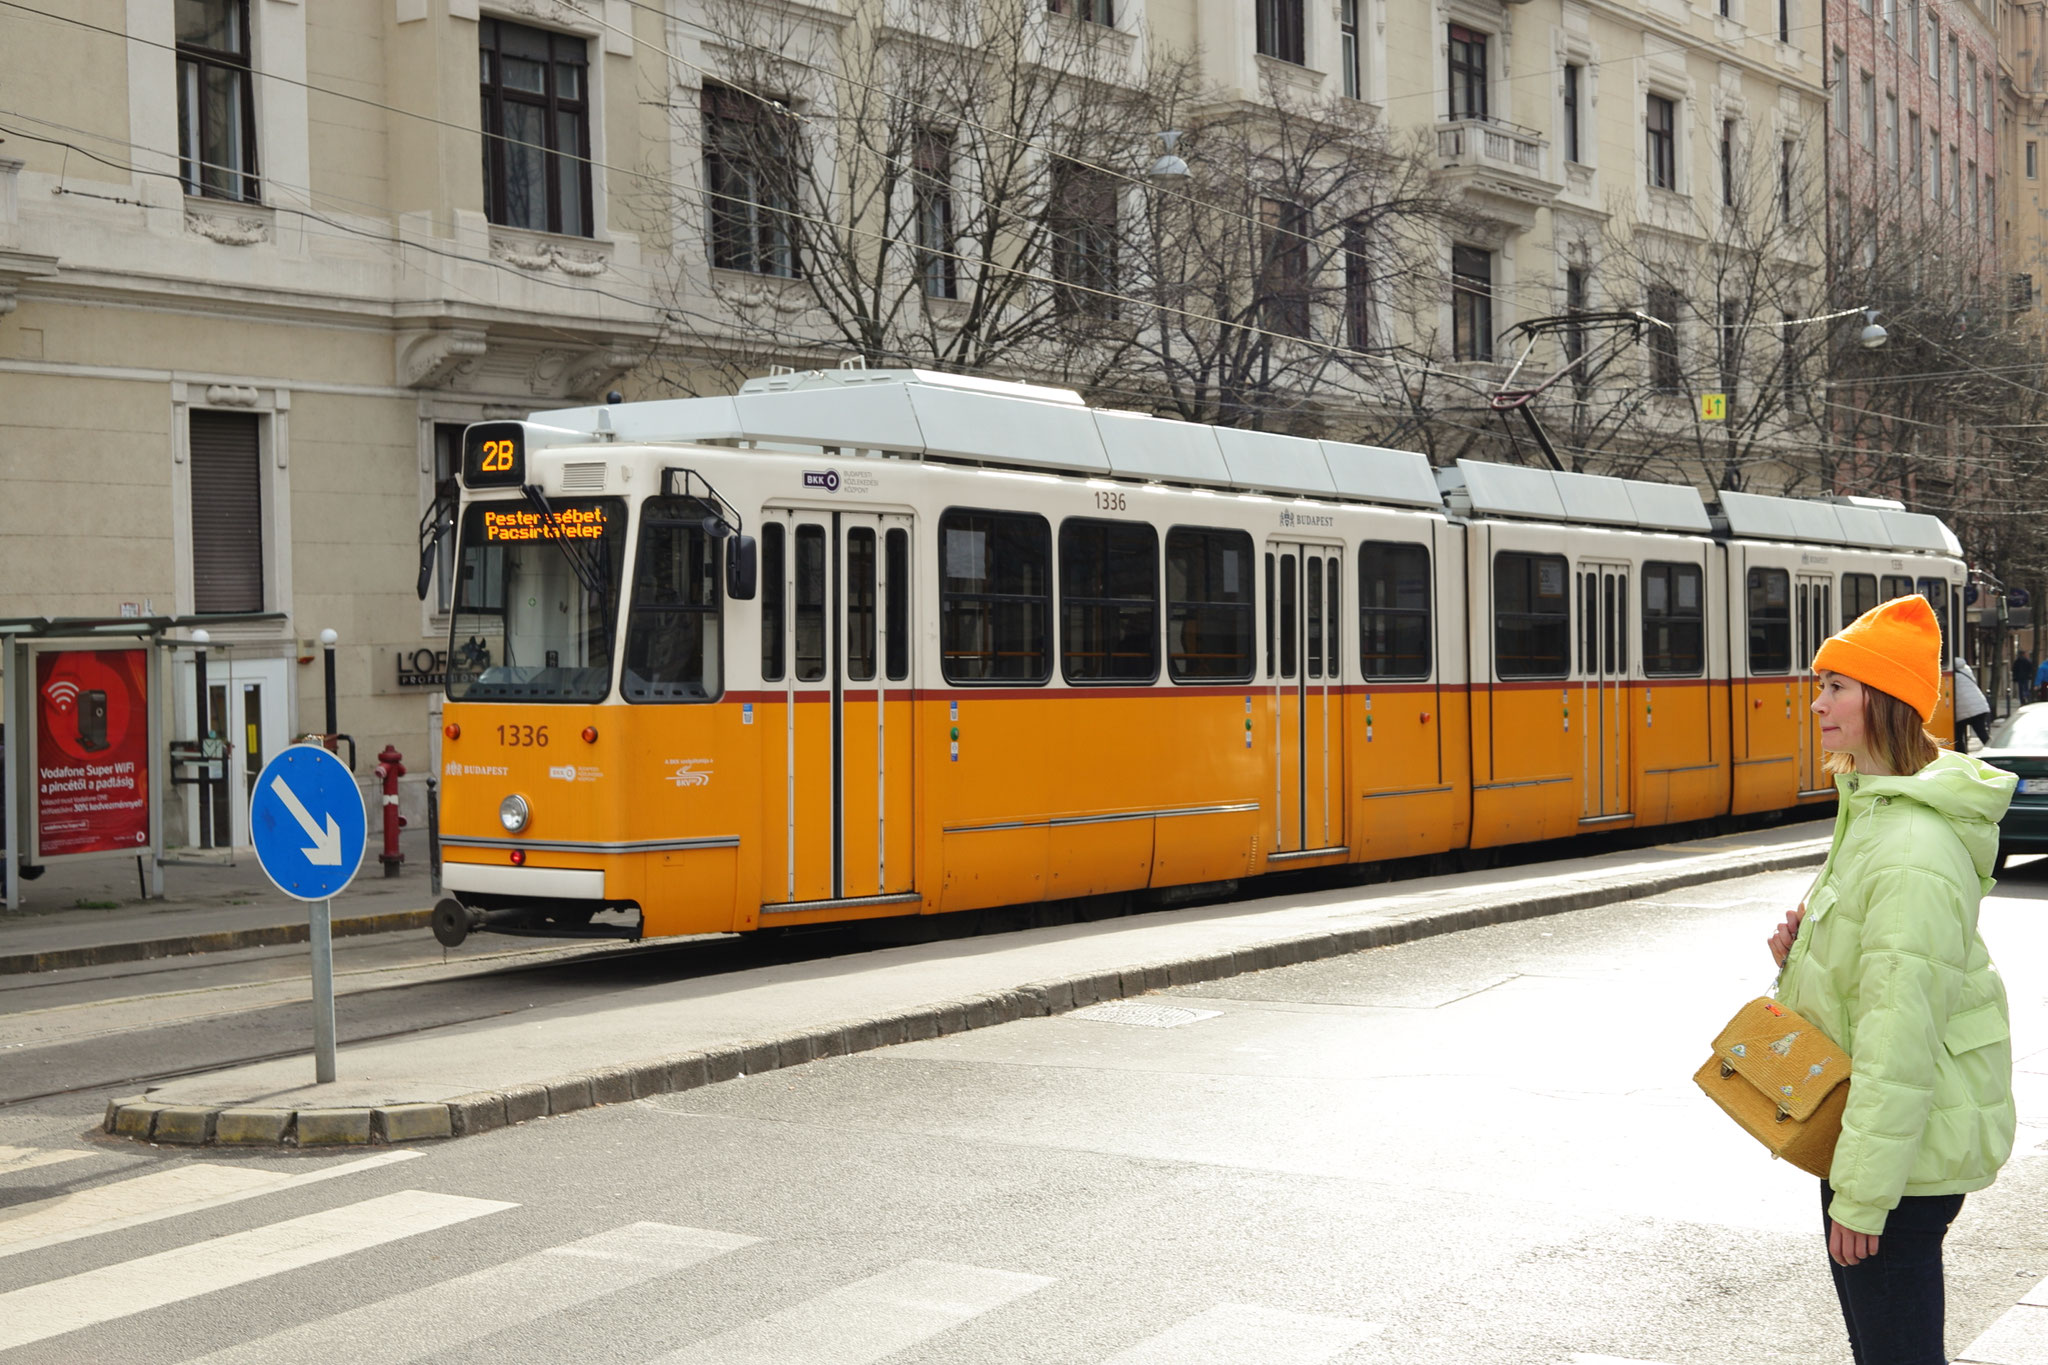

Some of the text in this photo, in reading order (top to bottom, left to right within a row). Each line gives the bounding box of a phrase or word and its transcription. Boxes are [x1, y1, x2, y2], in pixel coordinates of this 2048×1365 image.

[482, 440, 514, 471] 2B
[806, 475, 825, 485] BKK
[1094, 491, 1127, 511] 1336
[1296, 514, 1334, 528] BUDAPEST
[497, 725, 549, 748] 1336
[40, 766, 85, 779] Vodafone
[86, 763, 113, 777] Super
[464, 765, 509, 776] BUDAPEST
[41, 776, 134, 795] a pincétől a padlásig
